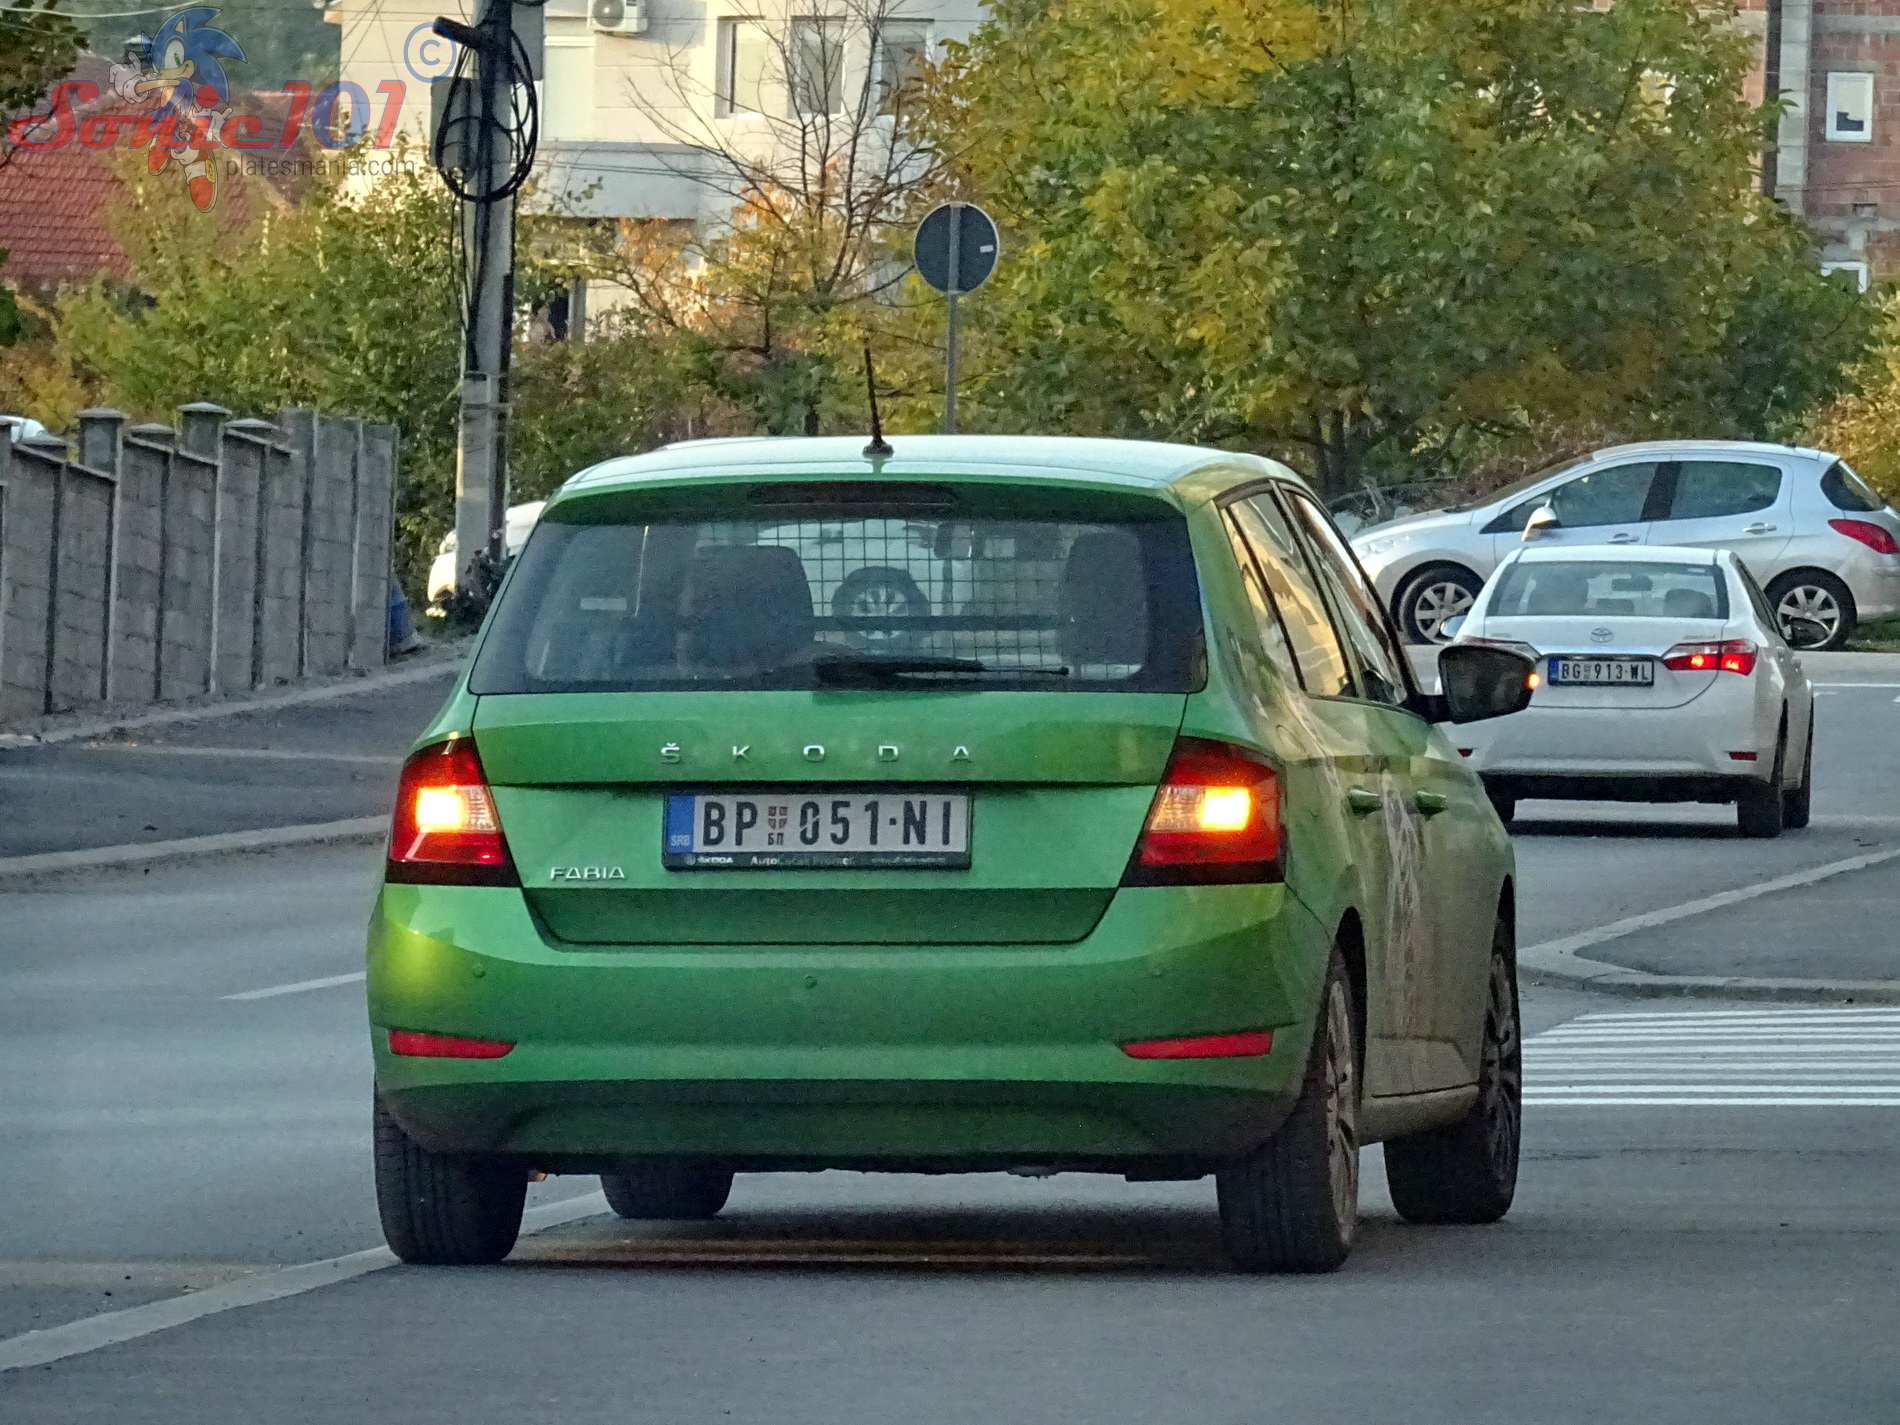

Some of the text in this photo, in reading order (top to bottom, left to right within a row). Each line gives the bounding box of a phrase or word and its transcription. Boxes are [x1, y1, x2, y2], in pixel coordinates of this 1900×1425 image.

[1562, 663, 1580, 679] BG
[660, 742, 971, 764] ŠKODA
[703, 801, 758, 846] BP
[670, 834, 690, 847] SRB
[550, 866, 626, 880] FABIA
